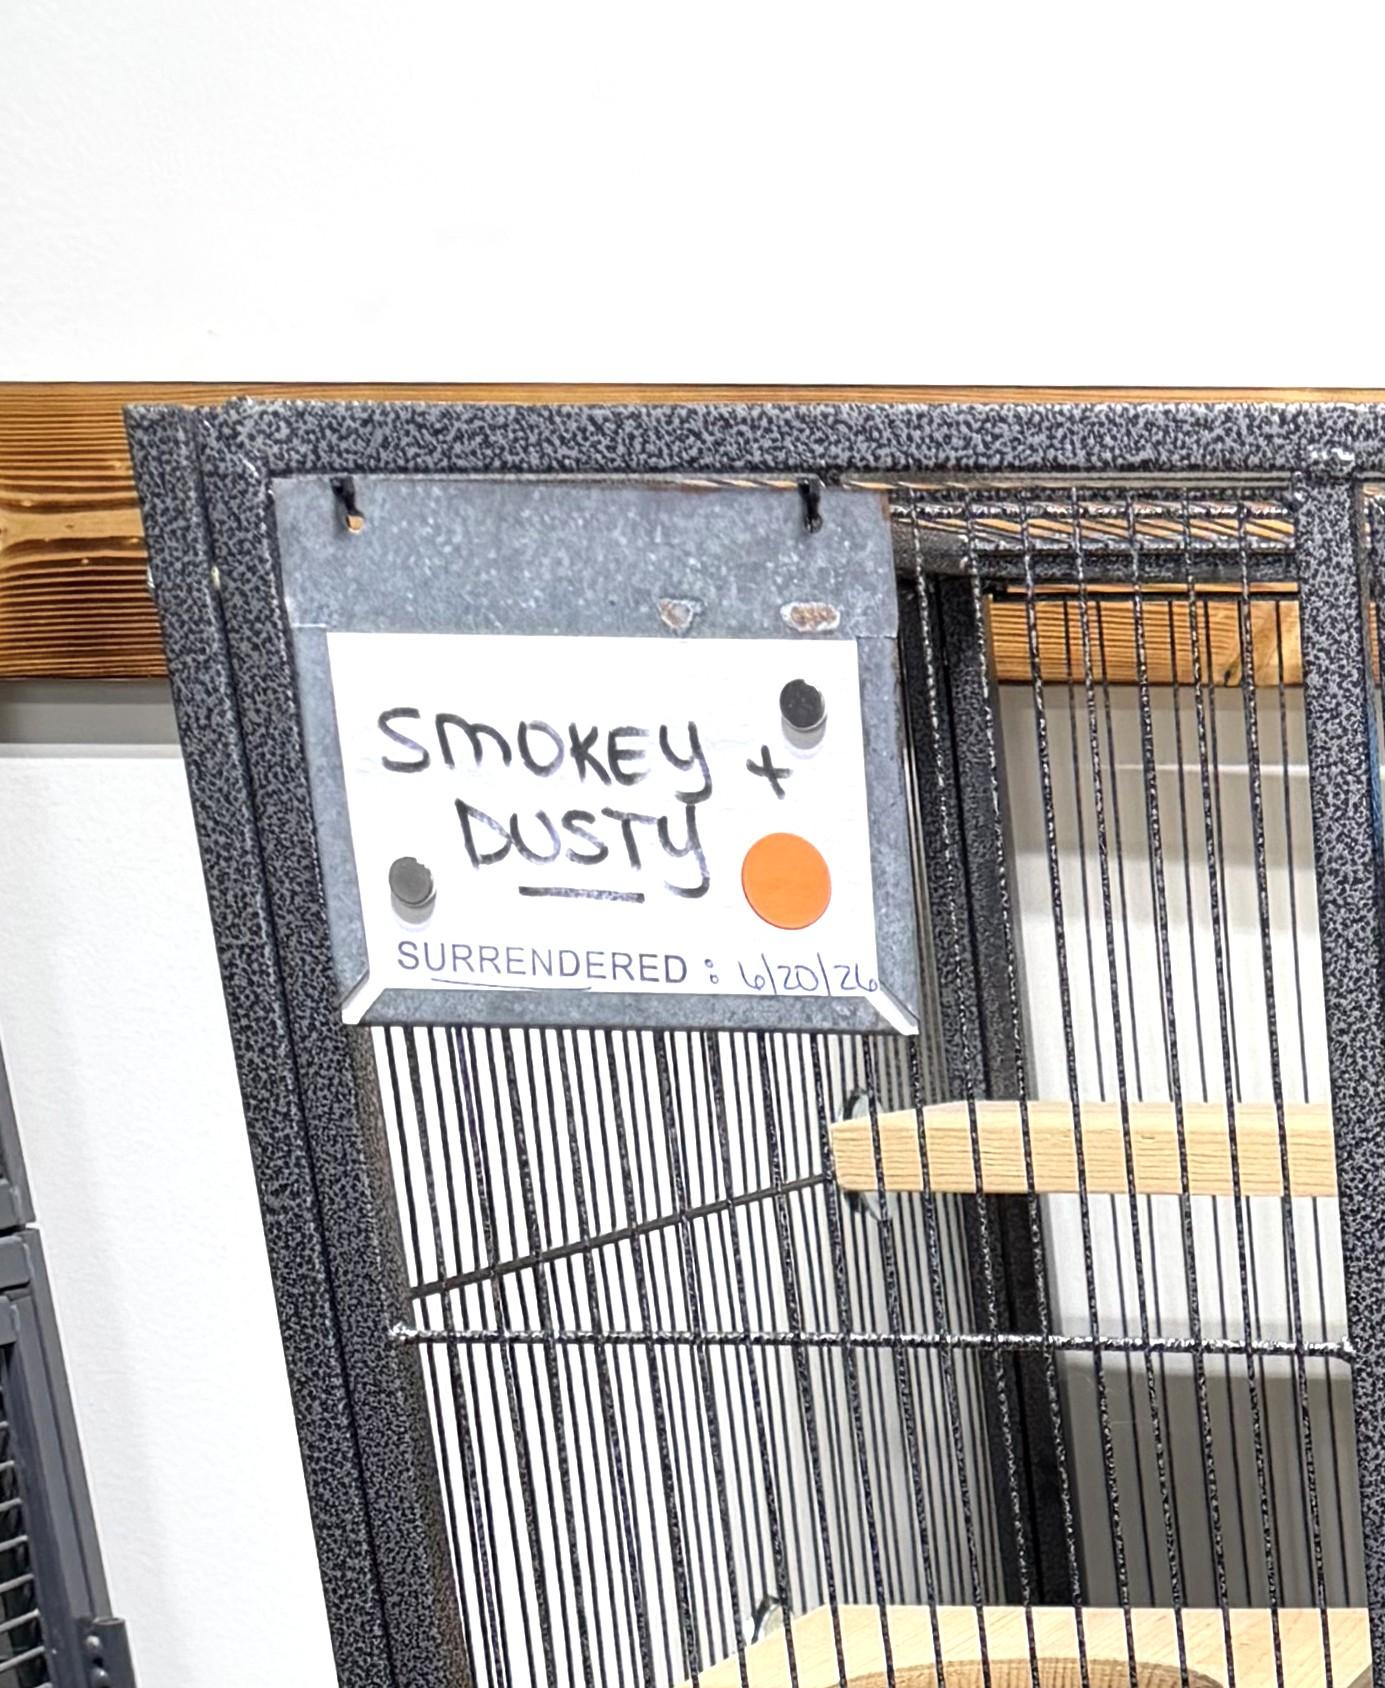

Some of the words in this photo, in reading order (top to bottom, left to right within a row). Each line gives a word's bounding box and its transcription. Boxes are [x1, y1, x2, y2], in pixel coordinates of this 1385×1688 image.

[378, 707, 712, 805] SMOKEY
[455, 797, 711, 898] DUSTY
[737, 952, 879, 997] 6/20/26
